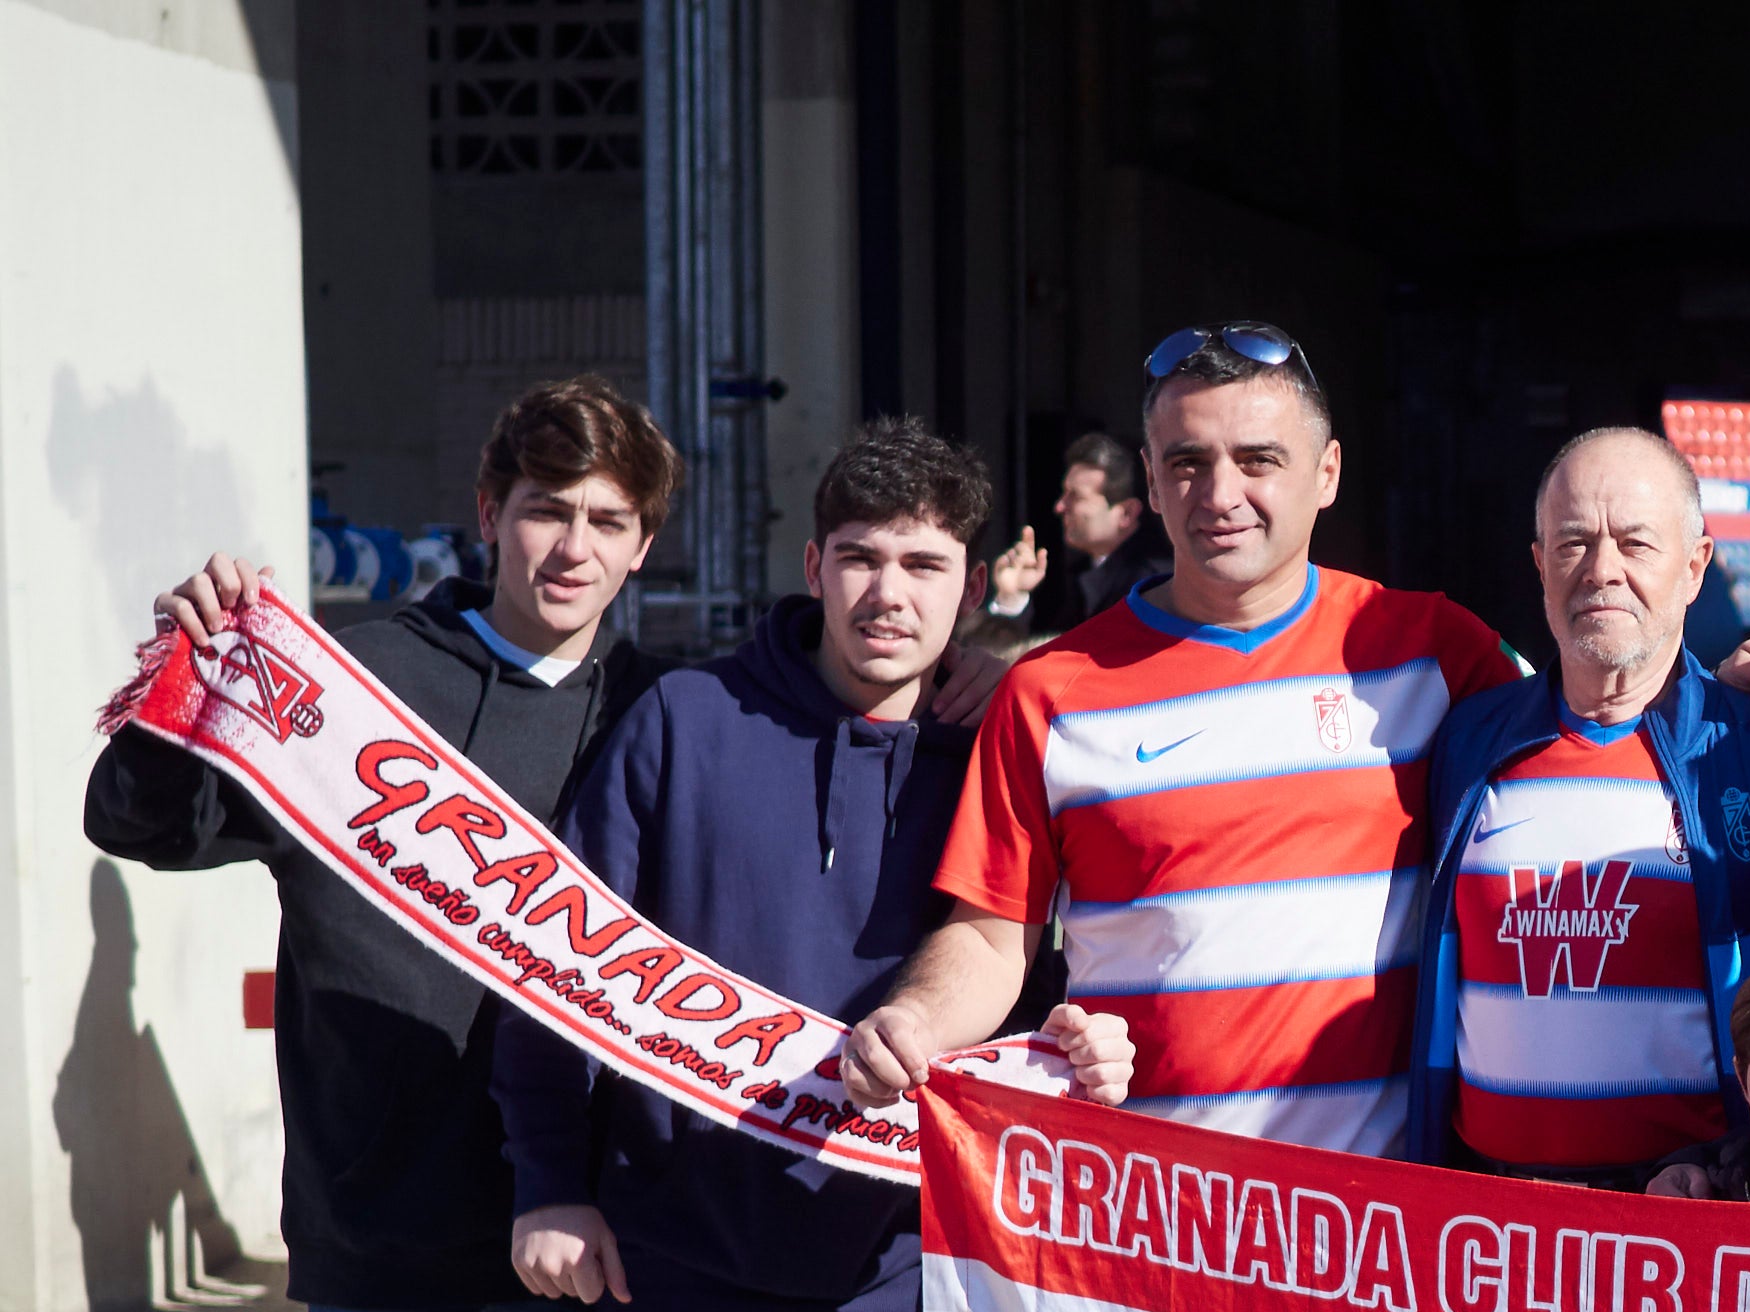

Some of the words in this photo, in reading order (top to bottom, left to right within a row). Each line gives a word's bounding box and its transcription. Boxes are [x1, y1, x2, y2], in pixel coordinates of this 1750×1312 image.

[346, 739, 805, 1066] GRANADA
[390, 862, 481, 926] sueño
[635, 1032, 744, 1090] somos
[741, 1079, 789, 1110] de
[1515, 909, 1615, 937] WINAMAX
